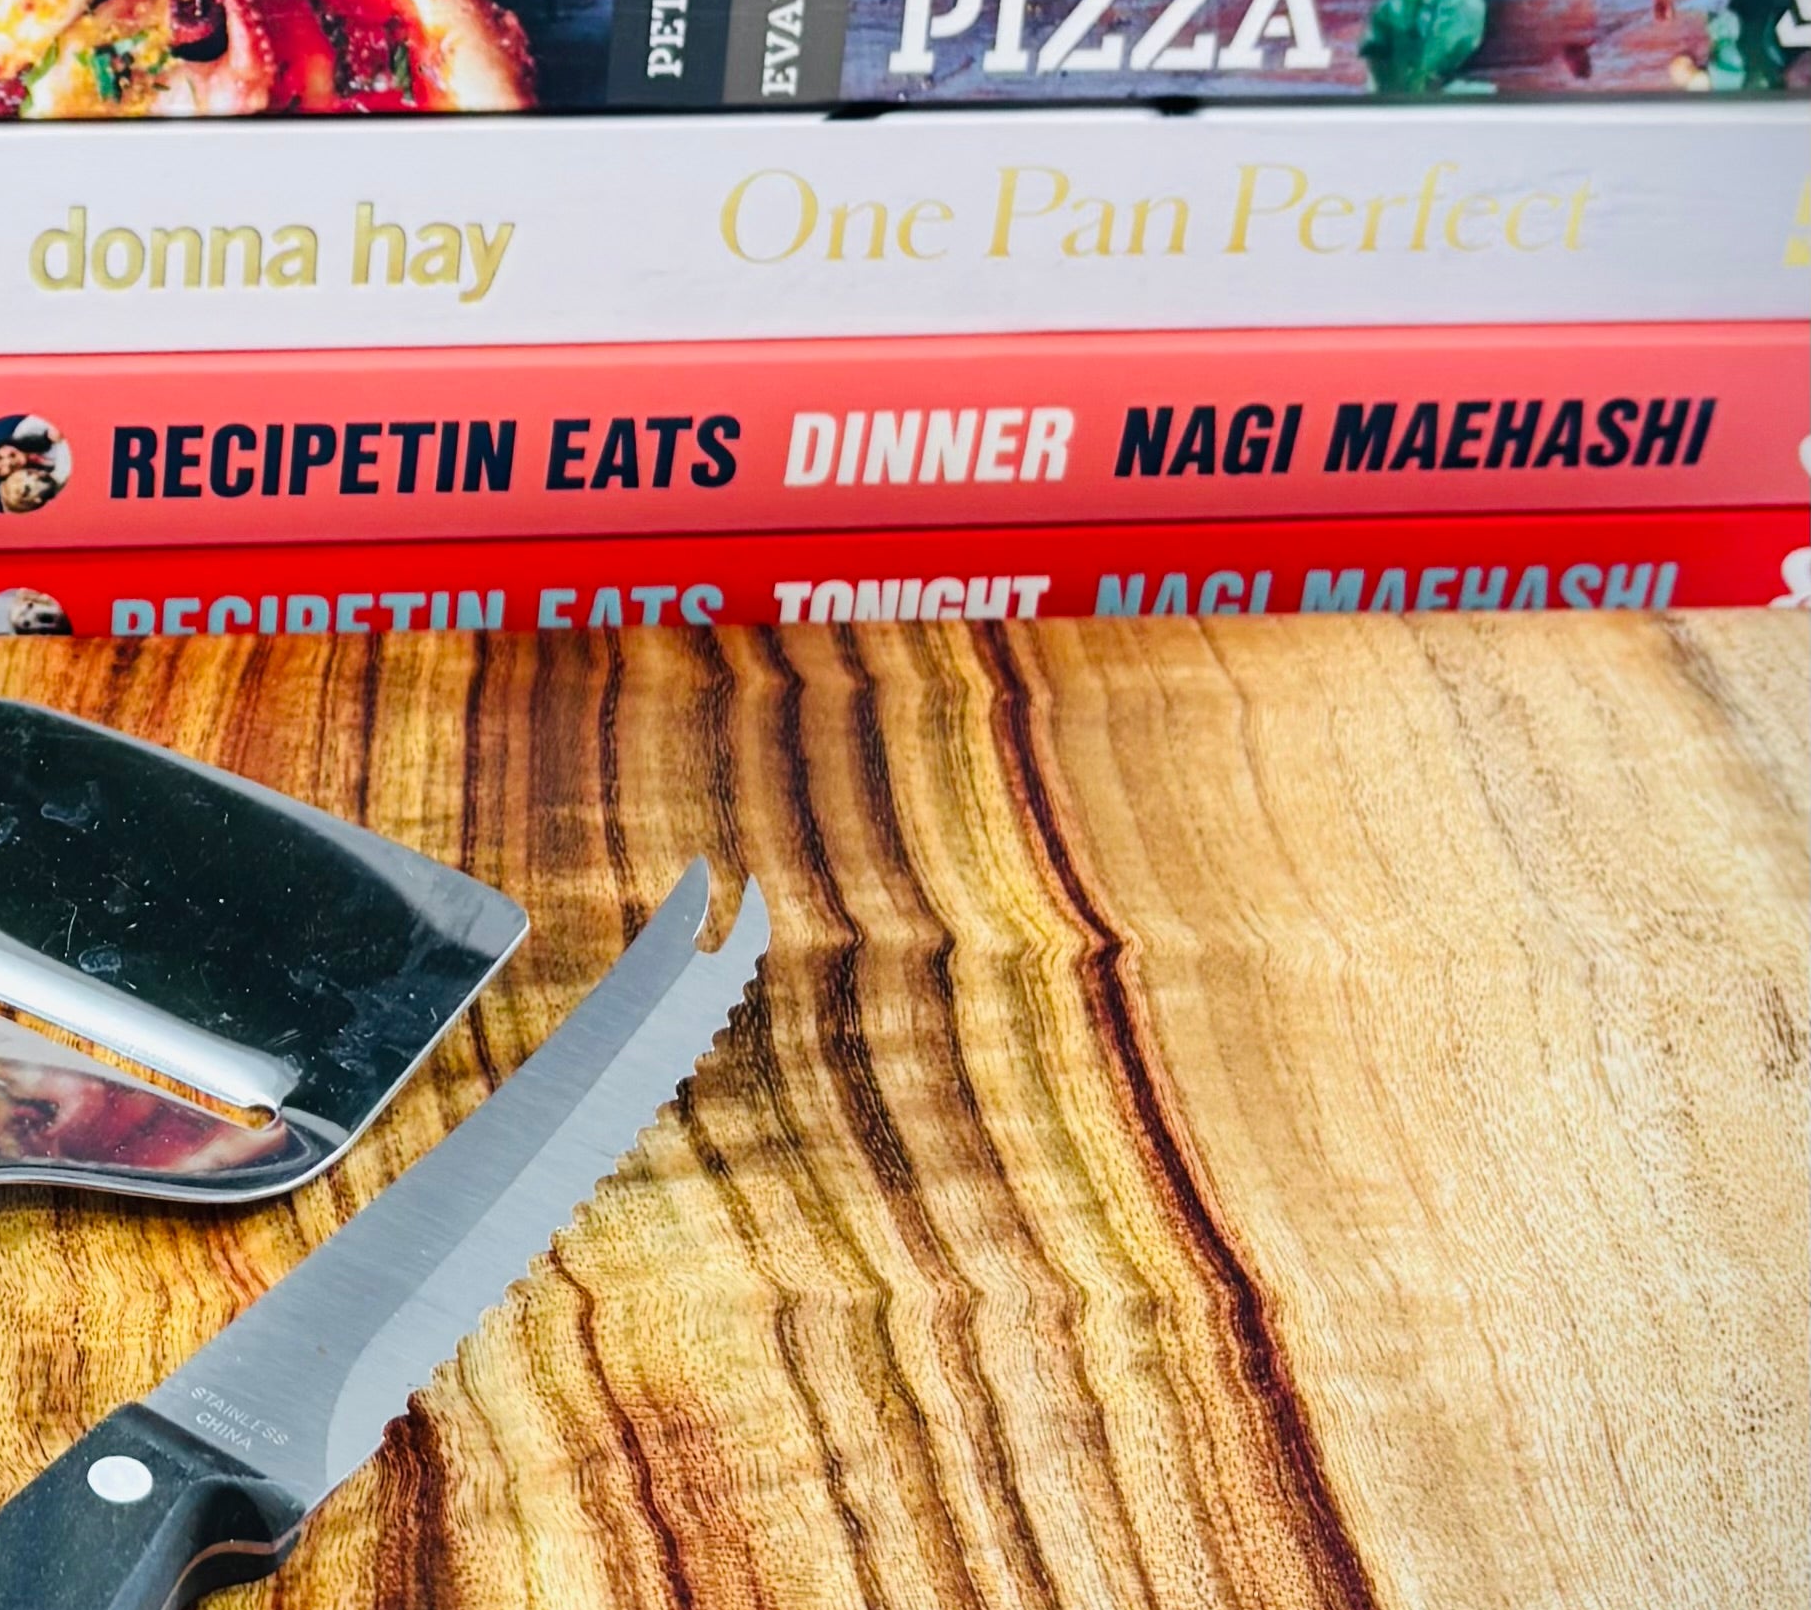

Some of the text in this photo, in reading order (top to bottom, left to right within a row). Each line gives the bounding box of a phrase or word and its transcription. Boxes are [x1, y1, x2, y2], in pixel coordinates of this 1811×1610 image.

[28, 201, 516, 304] donna hay
[716, 160, 1600, 265] One Pan Perfect
[109, 397, 1718, 500] RECIPETIN EATS DINNER NAGI MAEHASHI
[190, 1386, 290, 1447] STAINLESS
[195, 1411, 253, 1453] CHINA
